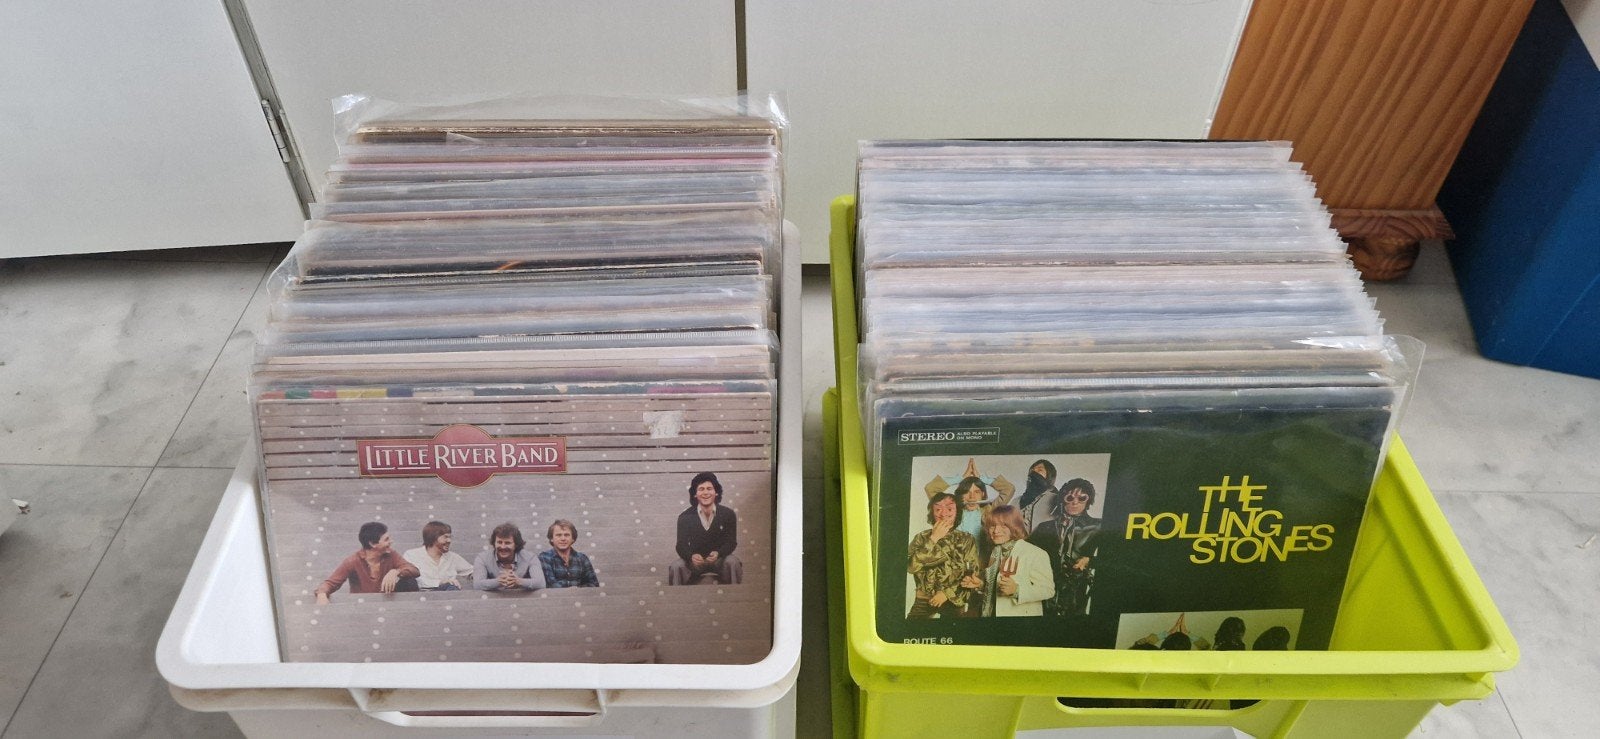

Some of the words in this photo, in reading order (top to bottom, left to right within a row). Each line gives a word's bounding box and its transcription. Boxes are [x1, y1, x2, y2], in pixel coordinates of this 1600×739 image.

[901, 432, 955, 442] STEREO
[365, 444, 431, 470] LITTLE
[434, 443, 498, 470] RIVER
[501, 442, 559, 468] BAND
[1198, 475, 1268, 513] THE
[1125, 507, 1283, 540] ROLLING
[1189, 524, 1335, 564] STONES
[903, 637, 937, 645] ROUTE
[940, 636, 953, 645] 66
